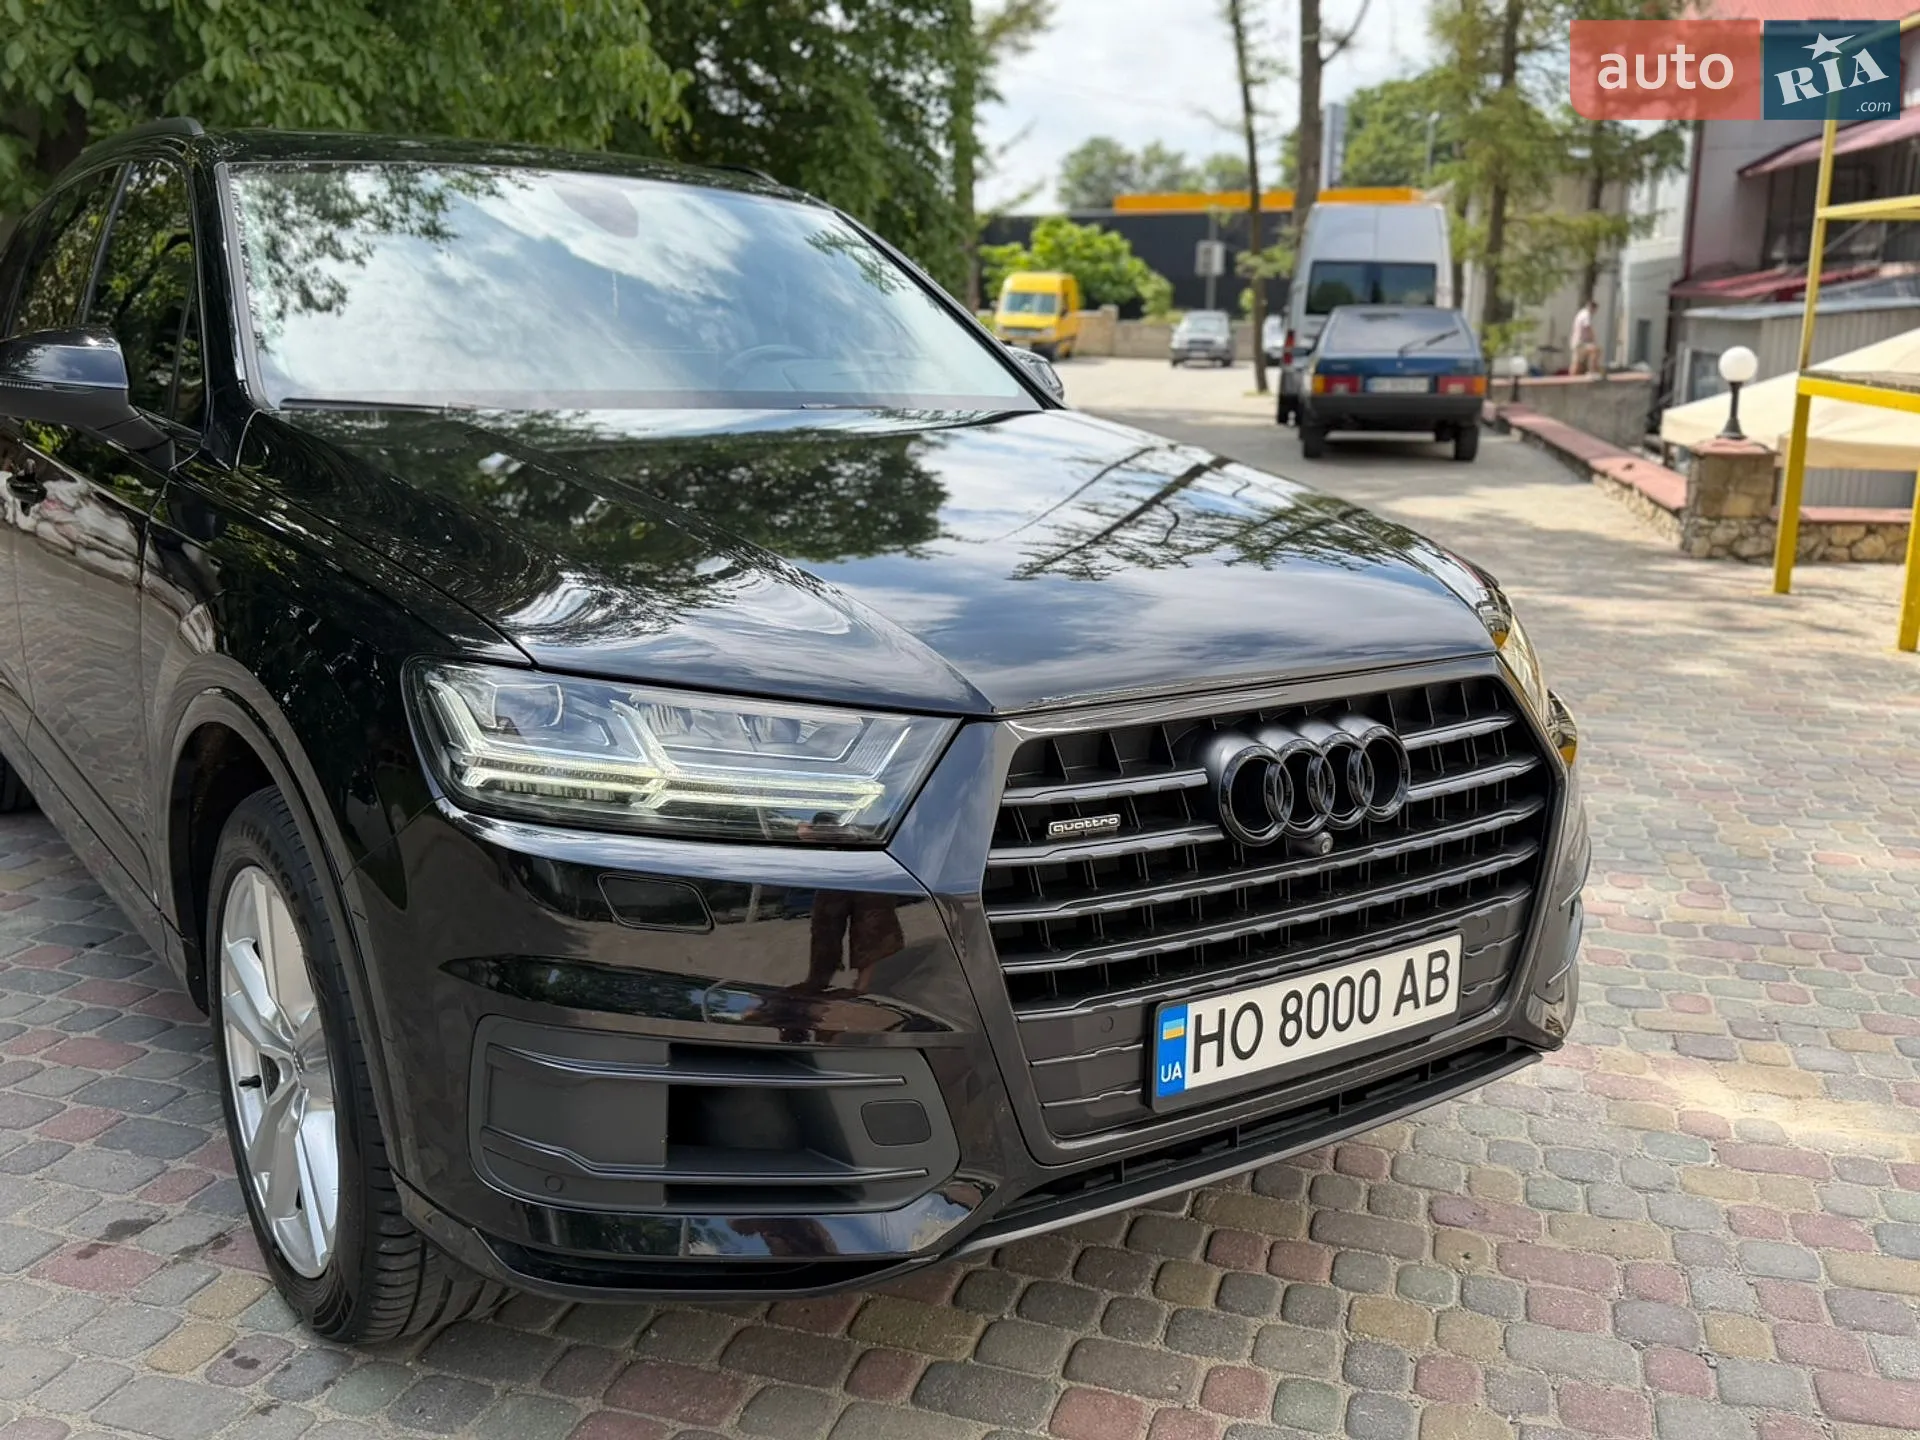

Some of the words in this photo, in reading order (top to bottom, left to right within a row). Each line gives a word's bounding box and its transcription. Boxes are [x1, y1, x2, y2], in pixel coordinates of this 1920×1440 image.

[1053, 817, 1118, 833] quattro
[239, 819, 313, 937] TRIANGLE
[1193, 1001, 1263, 1073] HO
[1279, 968, 1381, 1047] 8000
[1393, 949, 1450, 1017] AB
[1161, 1061, 1183, 1083] UA
